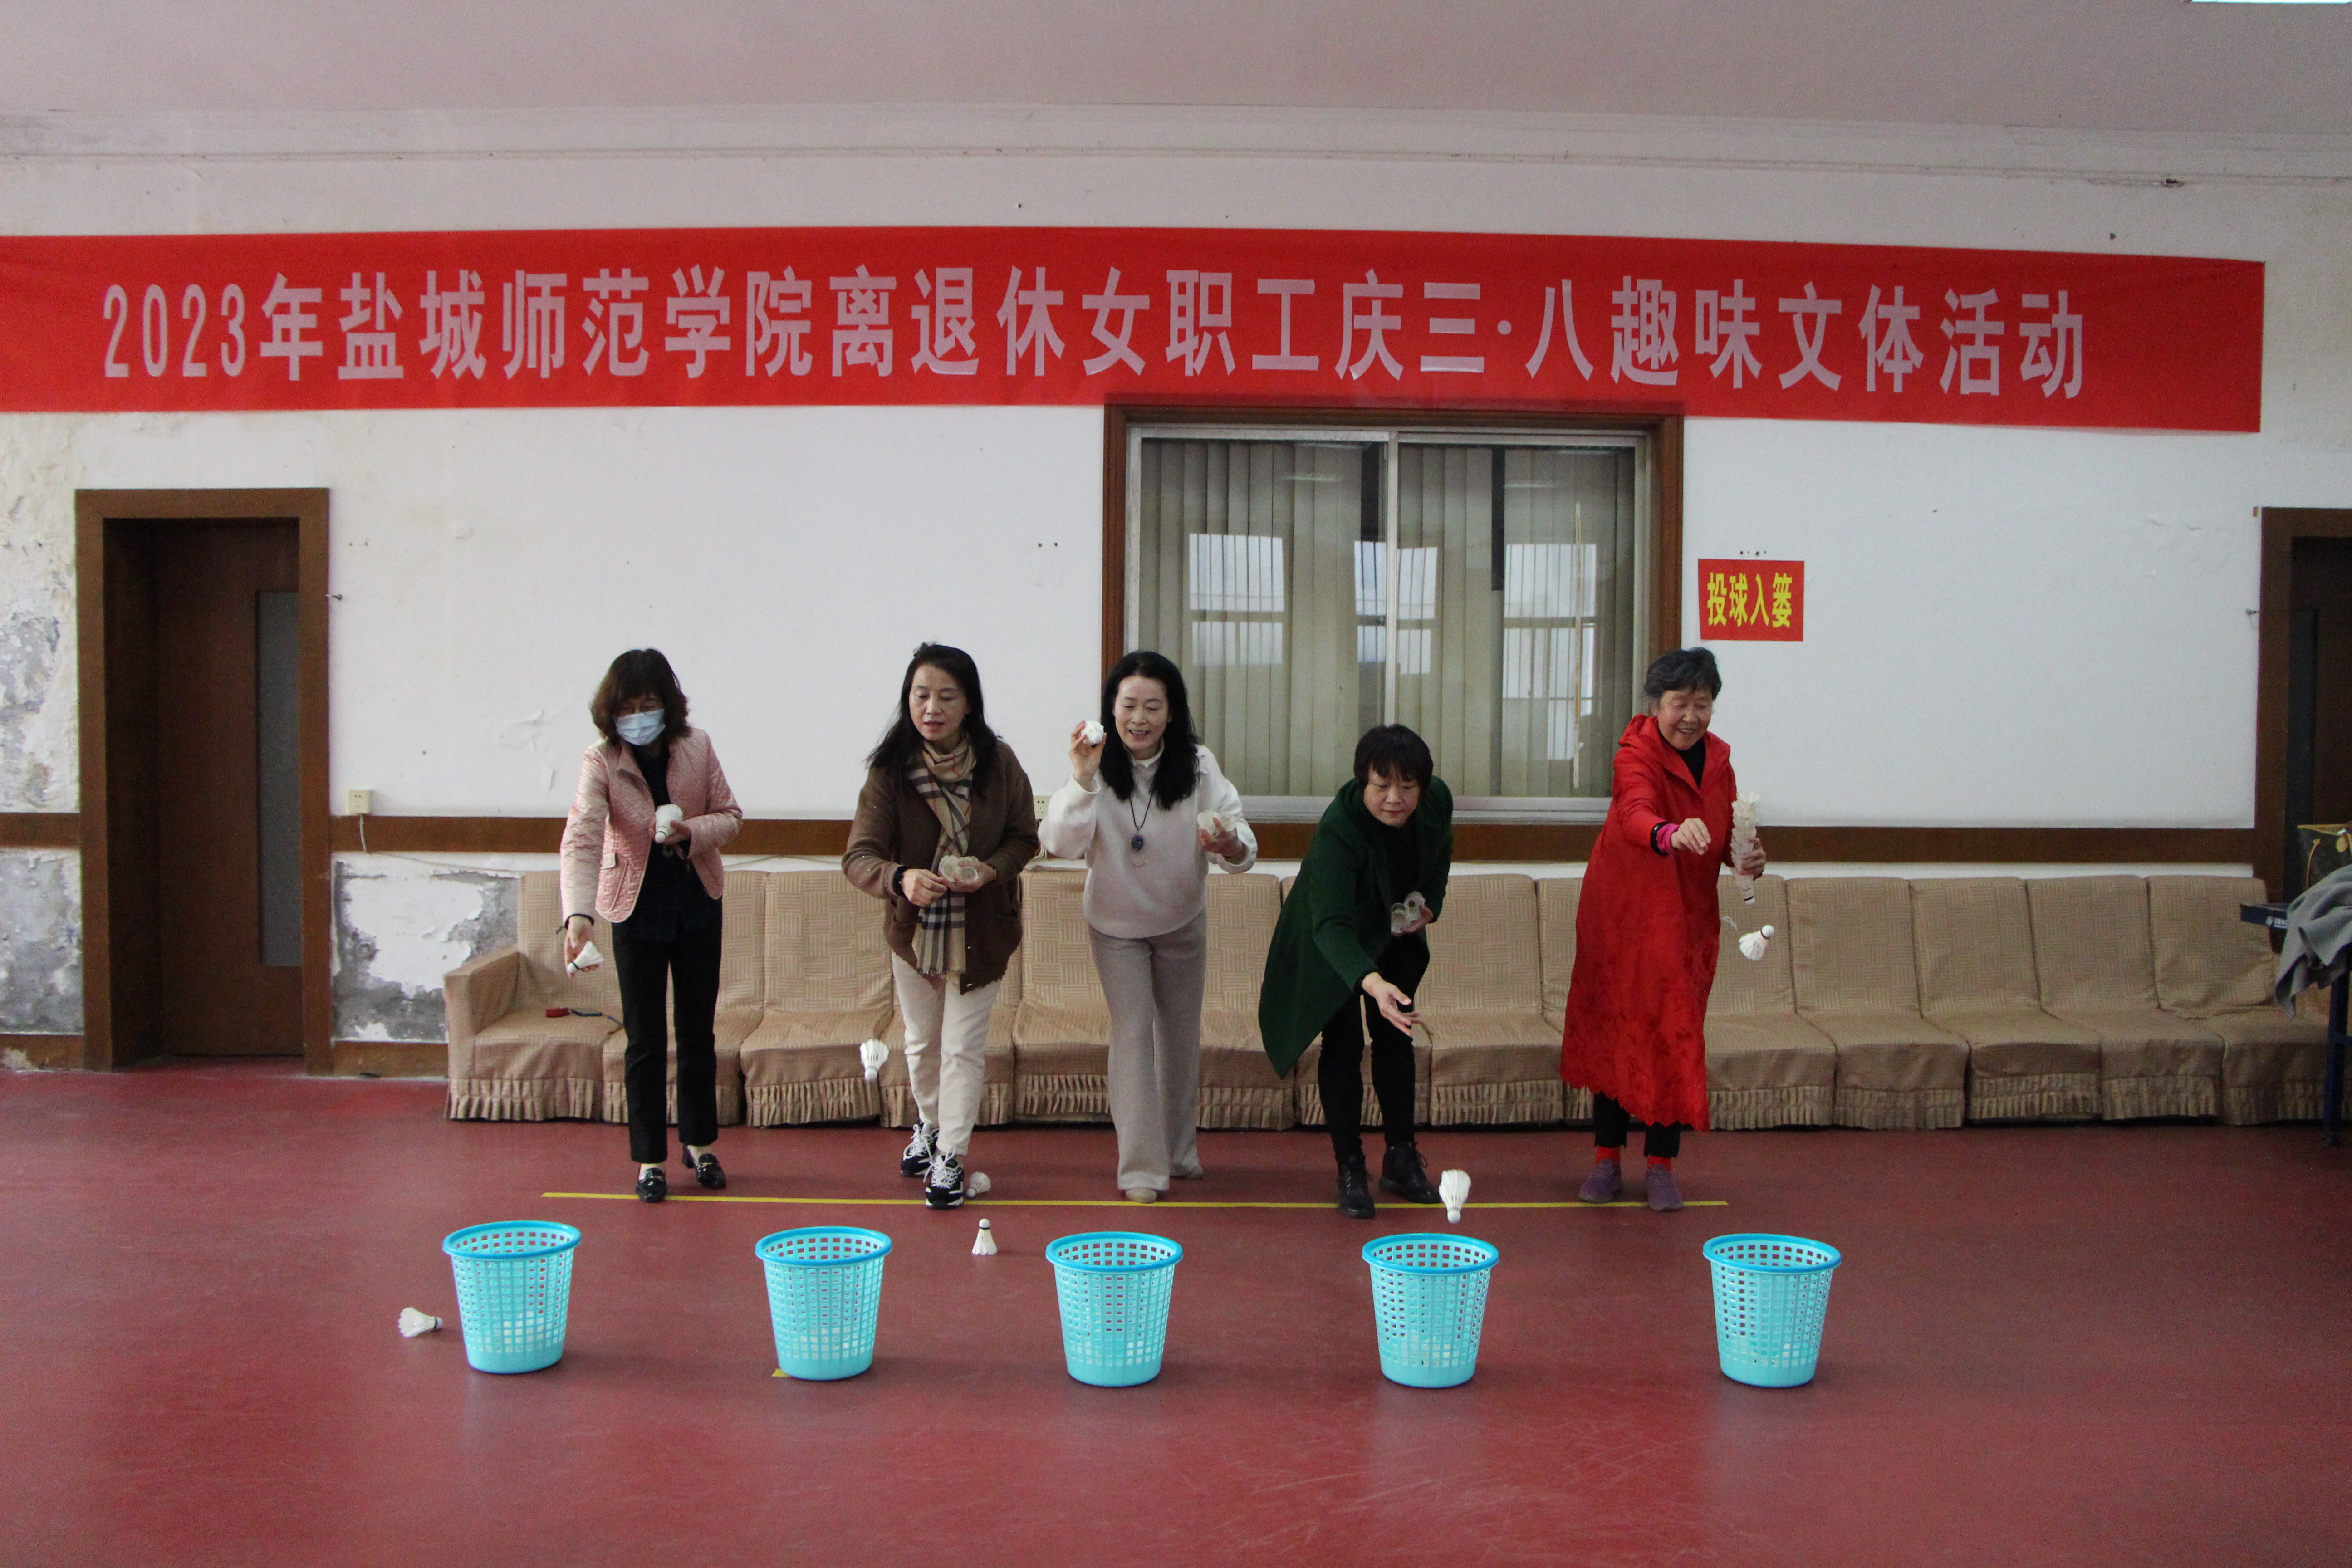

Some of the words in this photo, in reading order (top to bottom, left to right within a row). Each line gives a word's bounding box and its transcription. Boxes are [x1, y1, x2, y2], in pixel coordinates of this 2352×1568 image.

[103, 265, 2083, 399] 2023年盐城师范学院离退休女职工庆三·八趣味文体活动
[1707, 572, 1793, 628] 投球入篓
